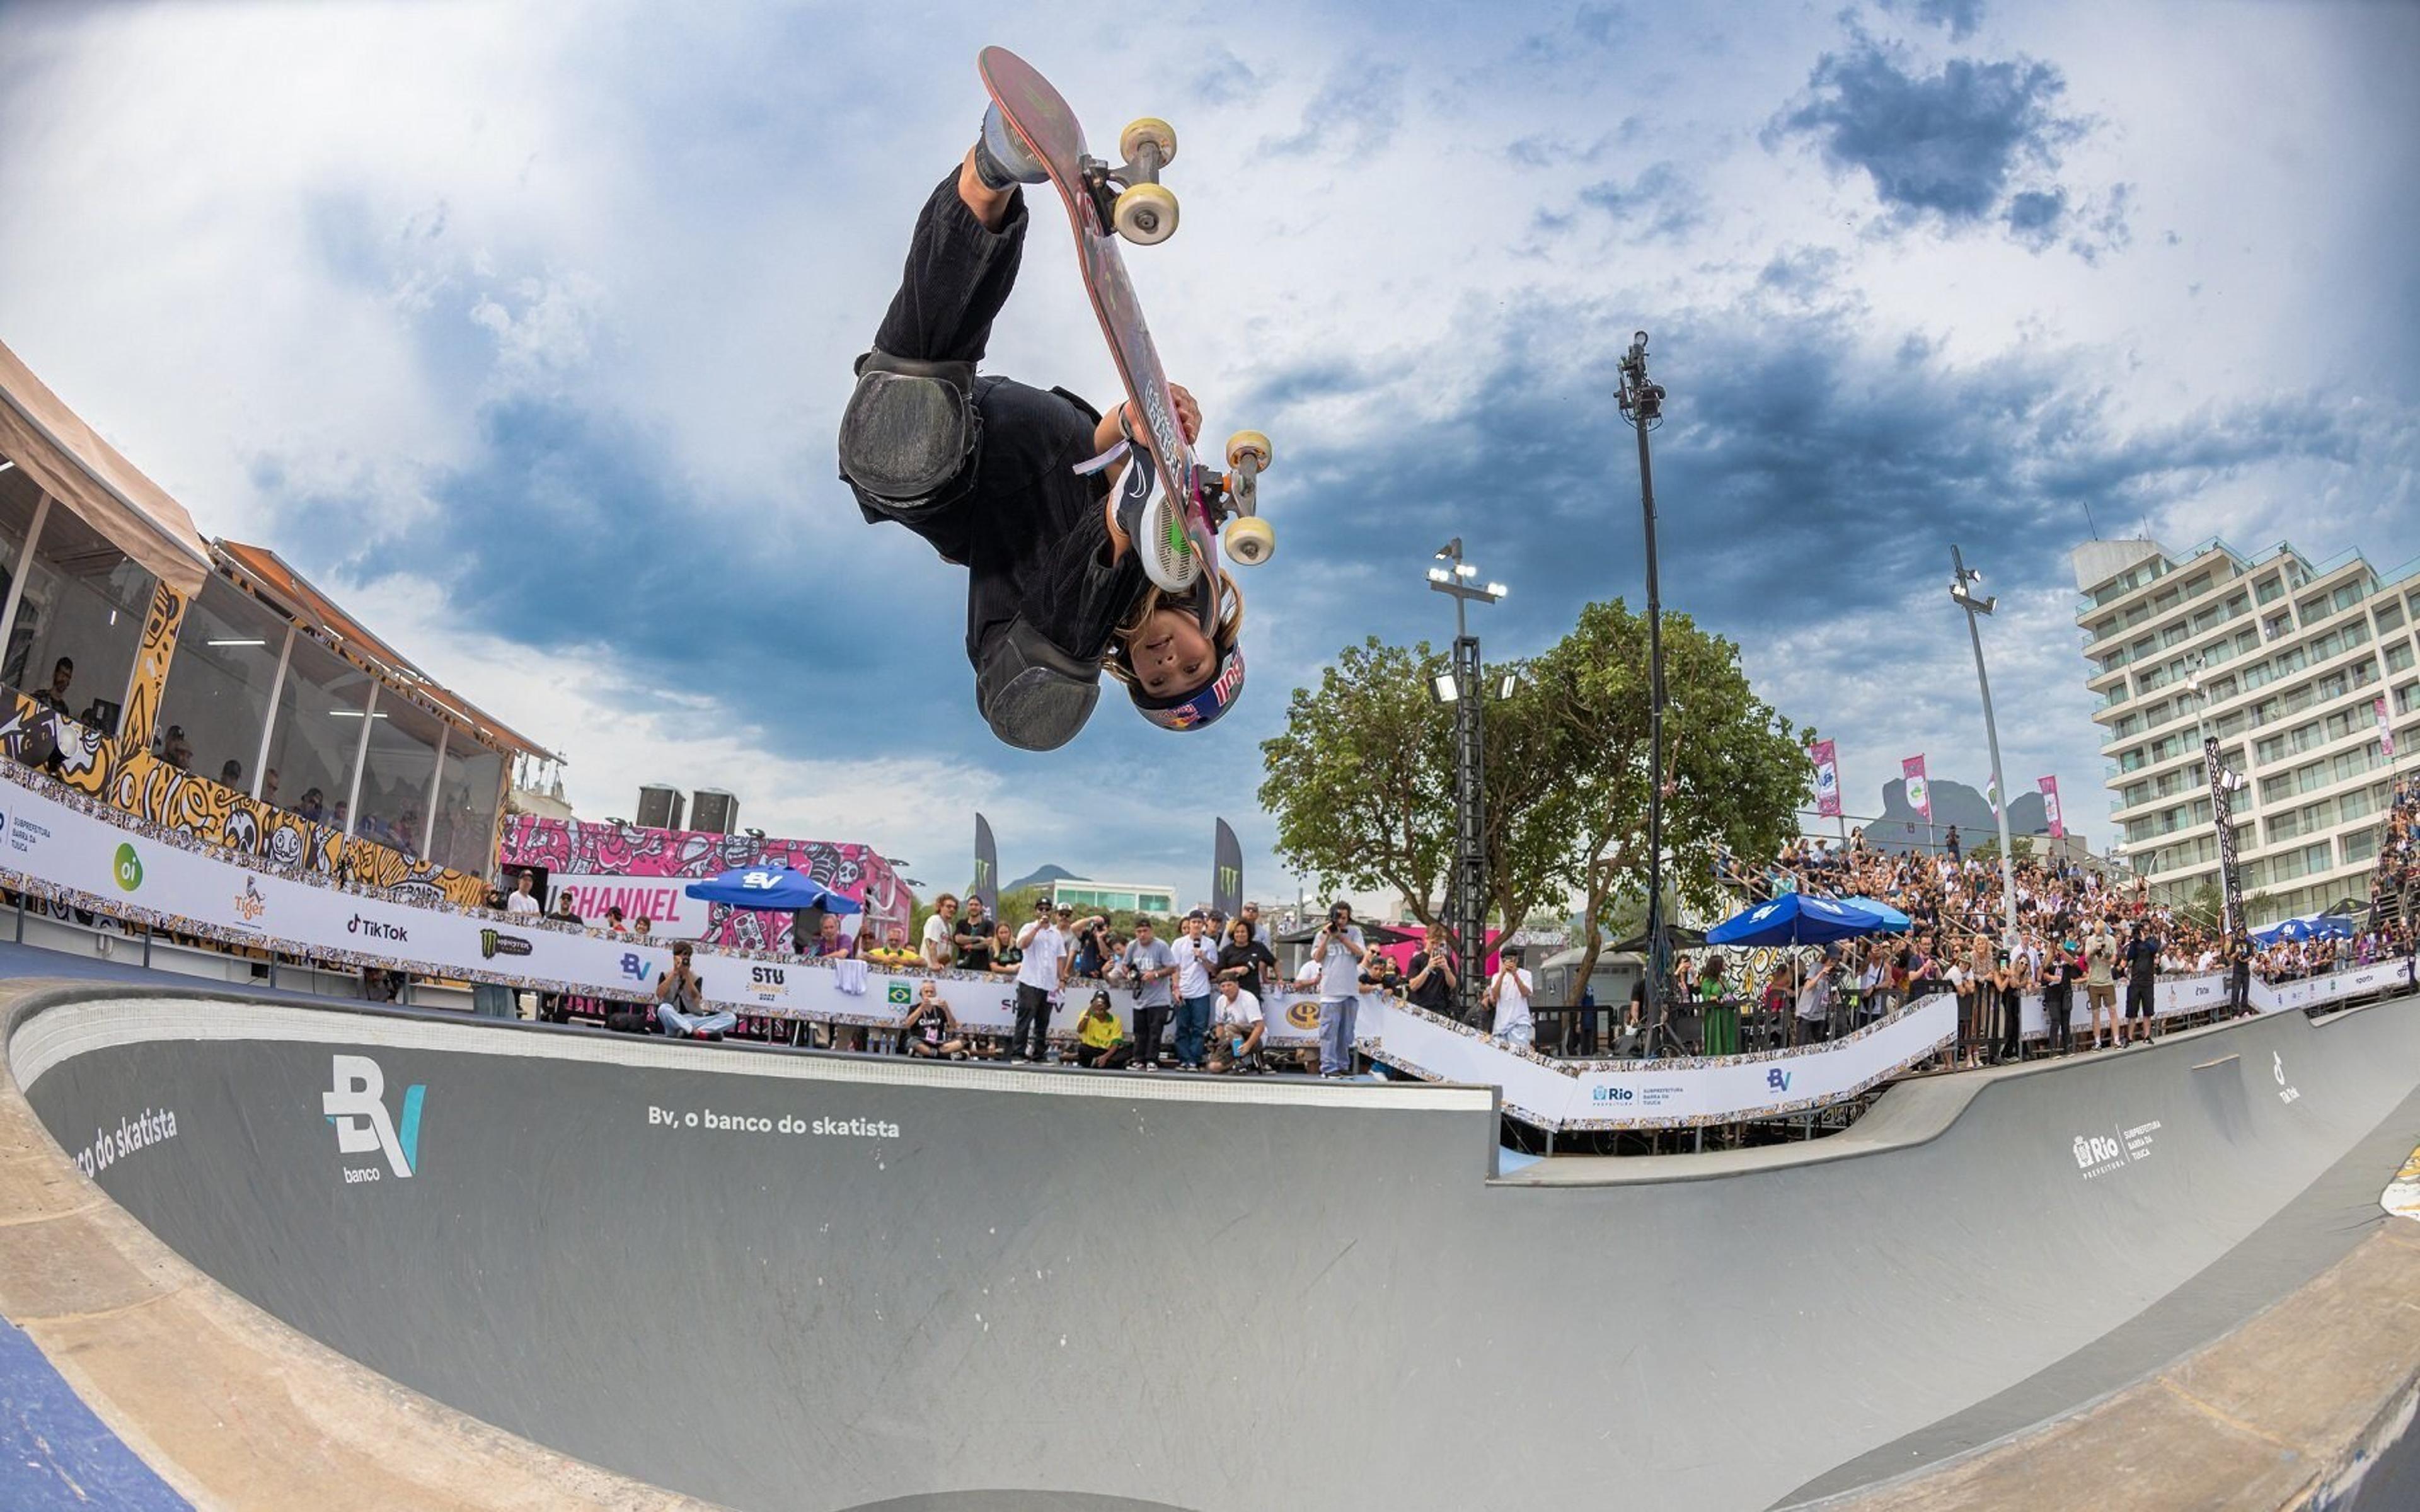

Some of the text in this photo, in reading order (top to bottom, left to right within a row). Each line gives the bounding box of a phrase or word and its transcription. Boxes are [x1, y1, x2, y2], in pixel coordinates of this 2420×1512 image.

[121, 856, 137, 881] oi
[234, 895, 265, 920] Tiger
[566, 885, 680, 922] CHANNEL
[362, 920, 408, 942] TikTok
[621, 953, 651, 980] BV
[752, 966, 784, 985] STU
[1767, 1068, 1791, 1091] BV
[1609, 1088, 1633, 1100] Rio
[322, 1055, 427, 1177] BV
[648, 1106, 900, 1138] Bv, o banco do skatista
[95, 1127, 115, 1171] do
[116, 1108, 177, 1158] skatista
[2089, 1135, 2119, 1163] Rio
[343, 1167, 381, 1183] banco
